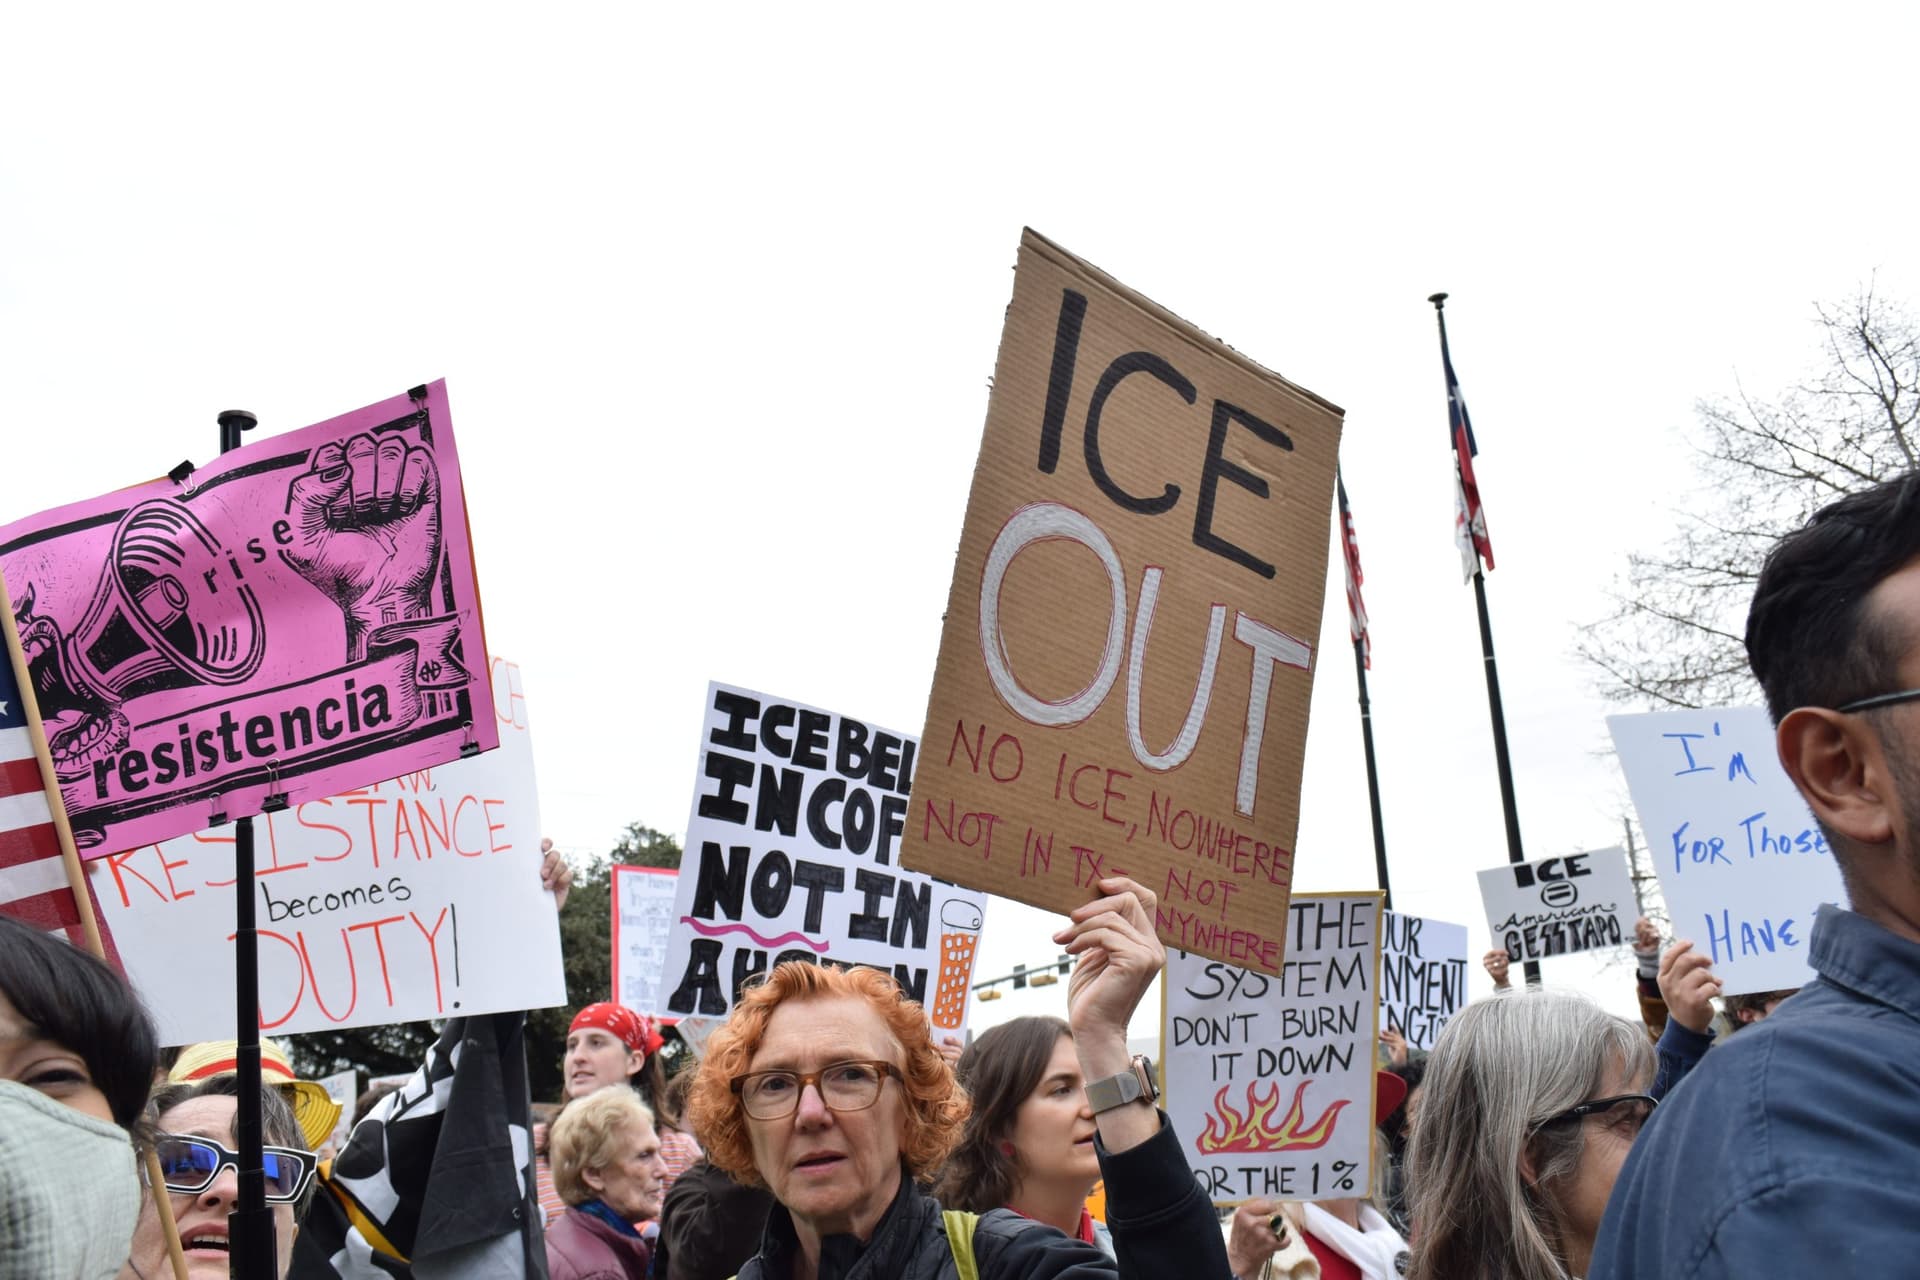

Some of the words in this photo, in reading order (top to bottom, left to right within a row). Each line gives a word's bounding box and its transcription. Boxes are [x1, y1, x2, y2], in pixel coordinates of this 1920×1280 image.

[1037, 288, 1294, 579] ICE
[203, 519, 294, 595] rise
[978, 501, 1314, 822] OUT
[90, 679, 392, 799] resistencia
[709, 689, 831, 772] ICE
[835, 716, 917, 796] BEL
[698, 750, 805, 838] IN
[806, 777, 908, 867] COF
[947, 719, 1024, 783] NO
[1054, 752, 1138, 843] ICE,
[1146, 790, 1291, 887] NOWHERE
[923, 798, 1003, 860] NOT
[1021, 826, 1054, 878] IN
[1163, 867, 1240, 922] NOT
[1513, 853, 1593, 889] ICE
[1672, 821, 1733, 874] FOR
[260, 876, 412, 923] becomes
[691, 840, 845, 934] NOT
[847, 867, 933, 950] IN
[1290, 901, 1373, 951] THE
[1494, 902, 1617, 933] American
[226, 902, 460, 1030] DUTY!
[1155, 905, 1281, 972] NYWHERE
[1184, 952, 1367, 1002] SYSTEM
[1382, 952, 1468, 1016] NMENT
[1173, 1012, 1259, 1047] DON'T
[1281, 1000, 1360, 1041] BURN
[1211, 1052, 1243, 1082] IT
[1256, 1042, 1354, 1078] DOWN
[1194, 1165, 1237, 1198] OR
[1237, 1165, 1296, 1196] THE
